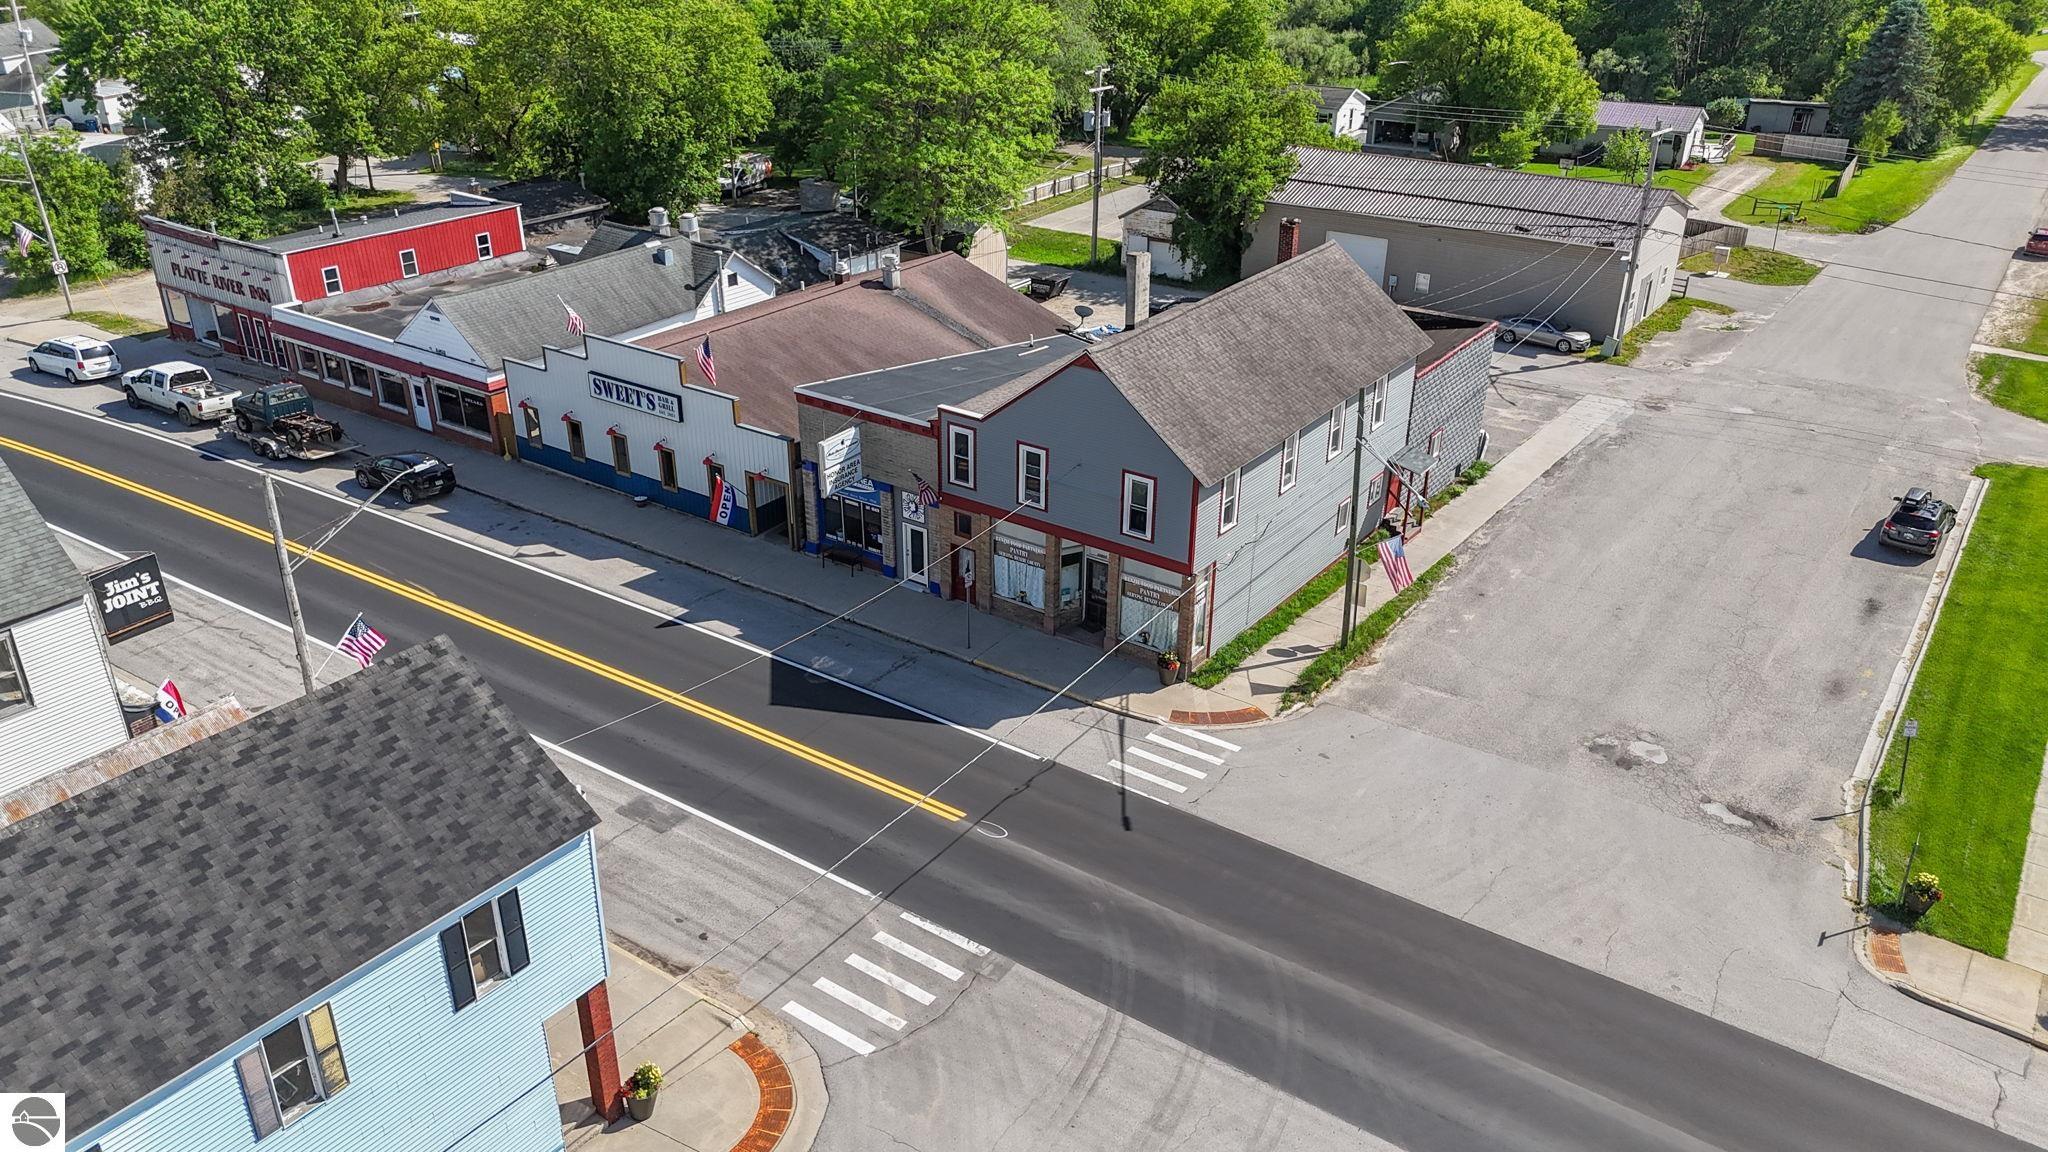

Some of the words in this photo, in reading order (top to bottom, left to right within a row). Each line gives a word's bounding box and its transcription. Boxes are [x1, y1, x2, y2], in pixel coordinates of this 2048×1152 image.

[171, 262, 210, 286] PLATTE
[212, 274, 245, 296] RIVER
[248, 285, 271, 303] INN
[593, 377, 656, 411] SWEET'S
[657, 395, 669, 405] BAR
[658, 403, 675, 412] GRILL
[827, 466, 846, 479] HONOR
[847, 459, 860, 470] AREA
[829, 467, 858, 486] INSURANCE
[834, 475, 856, 490] AGENCY
[719, 485, 732, 519] OPEN
[1010, 547, 1028, 557] PANTRY
[104, 572, 152, 597] Jim's
[1140, 587, 1160, 600] PANTRY
[103, 581, 160, 613] JOINT
[139, 596, 164, 609] BBQ
